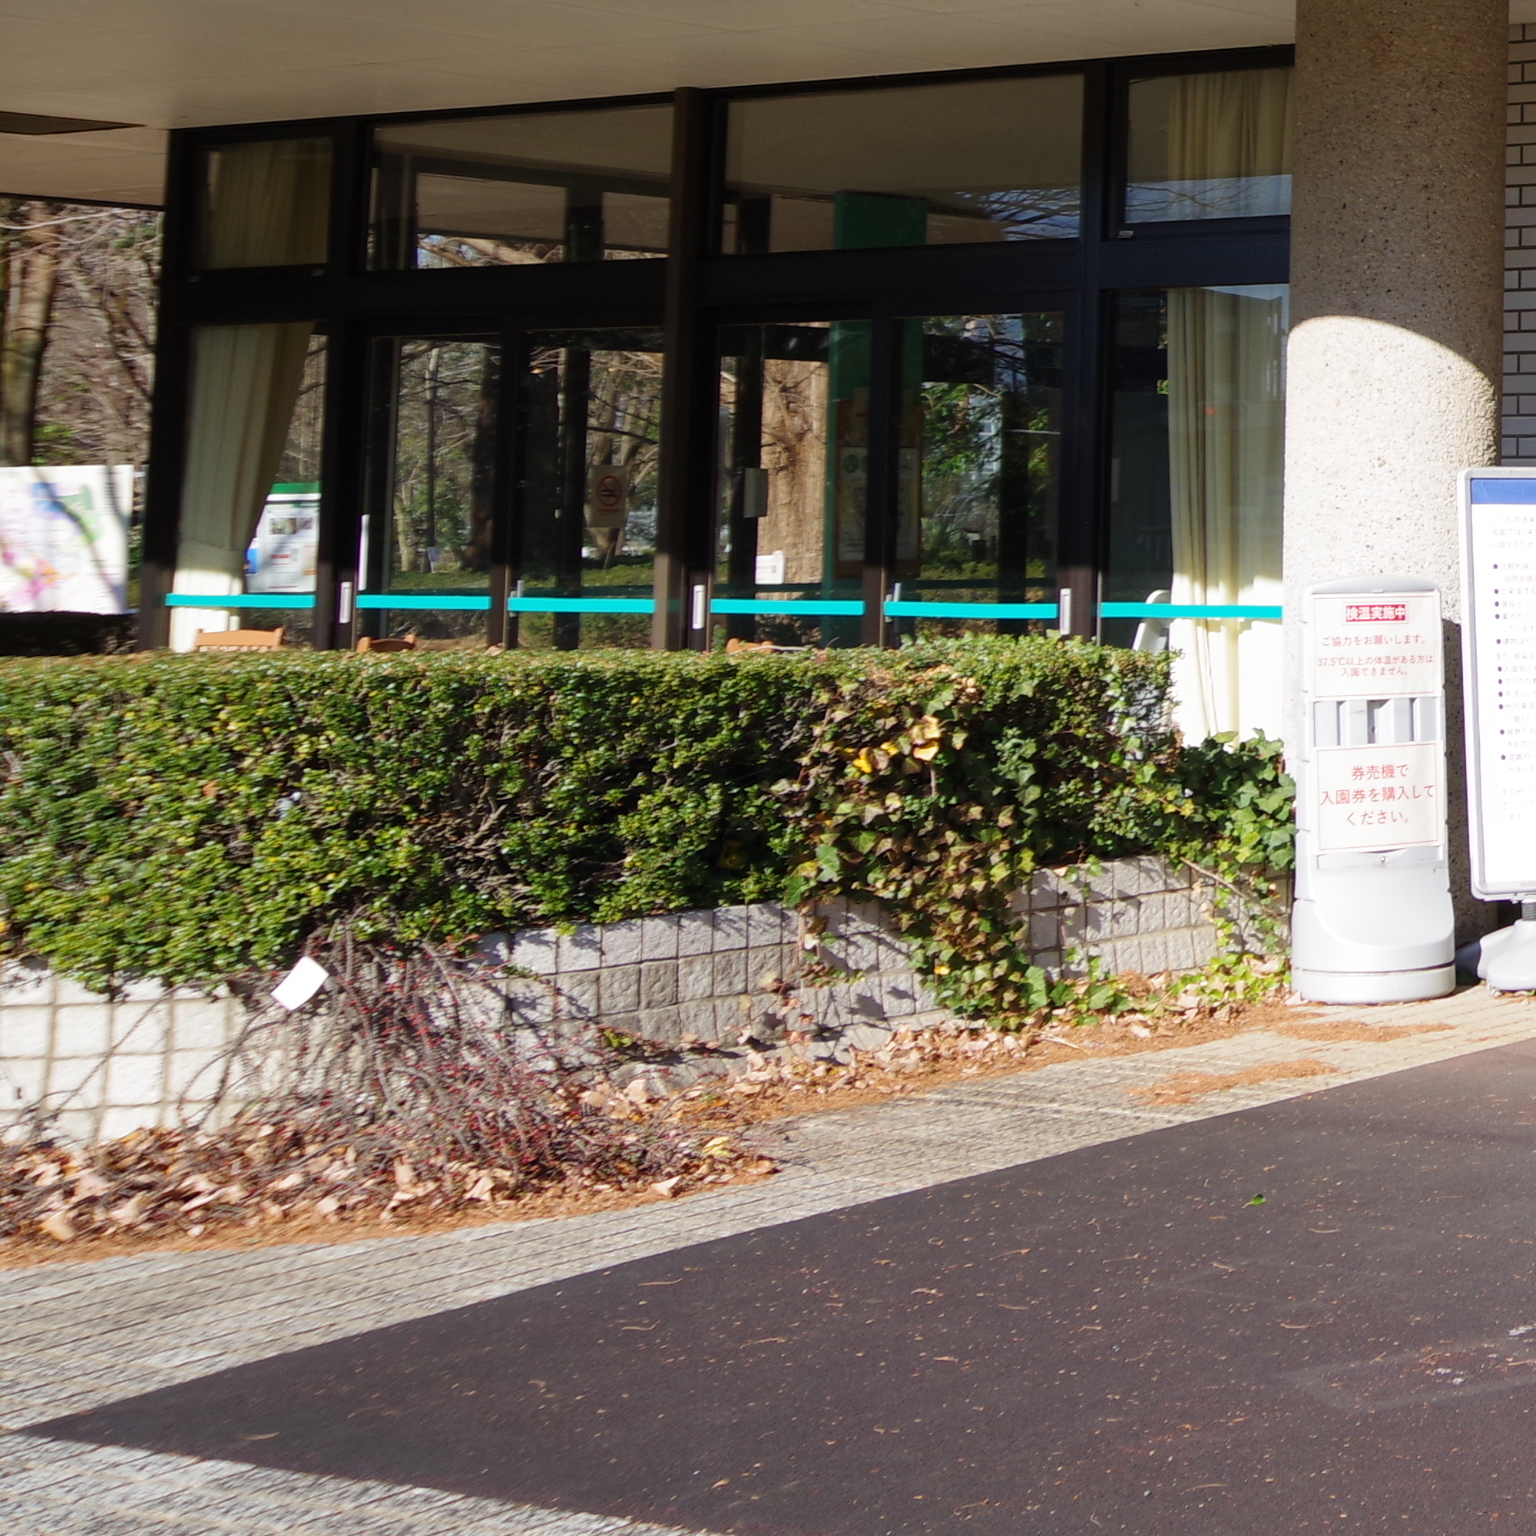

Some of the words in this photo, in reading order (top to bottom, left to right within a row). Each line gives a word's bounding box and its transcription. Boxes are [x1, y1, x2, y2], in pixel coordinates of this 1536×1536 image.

[1346, 605, 1406, 621] 検温実施中
[1322, 634, 1426, 647] ご協力をお願いします。
[1341, 667, 1408, 678] 入園できません。
[1351, 764, 1409, 781] 券売機で
[1320, 784, 1435, 805] 入園券を購入して
[1347, 809, 1409, 825] ください。
